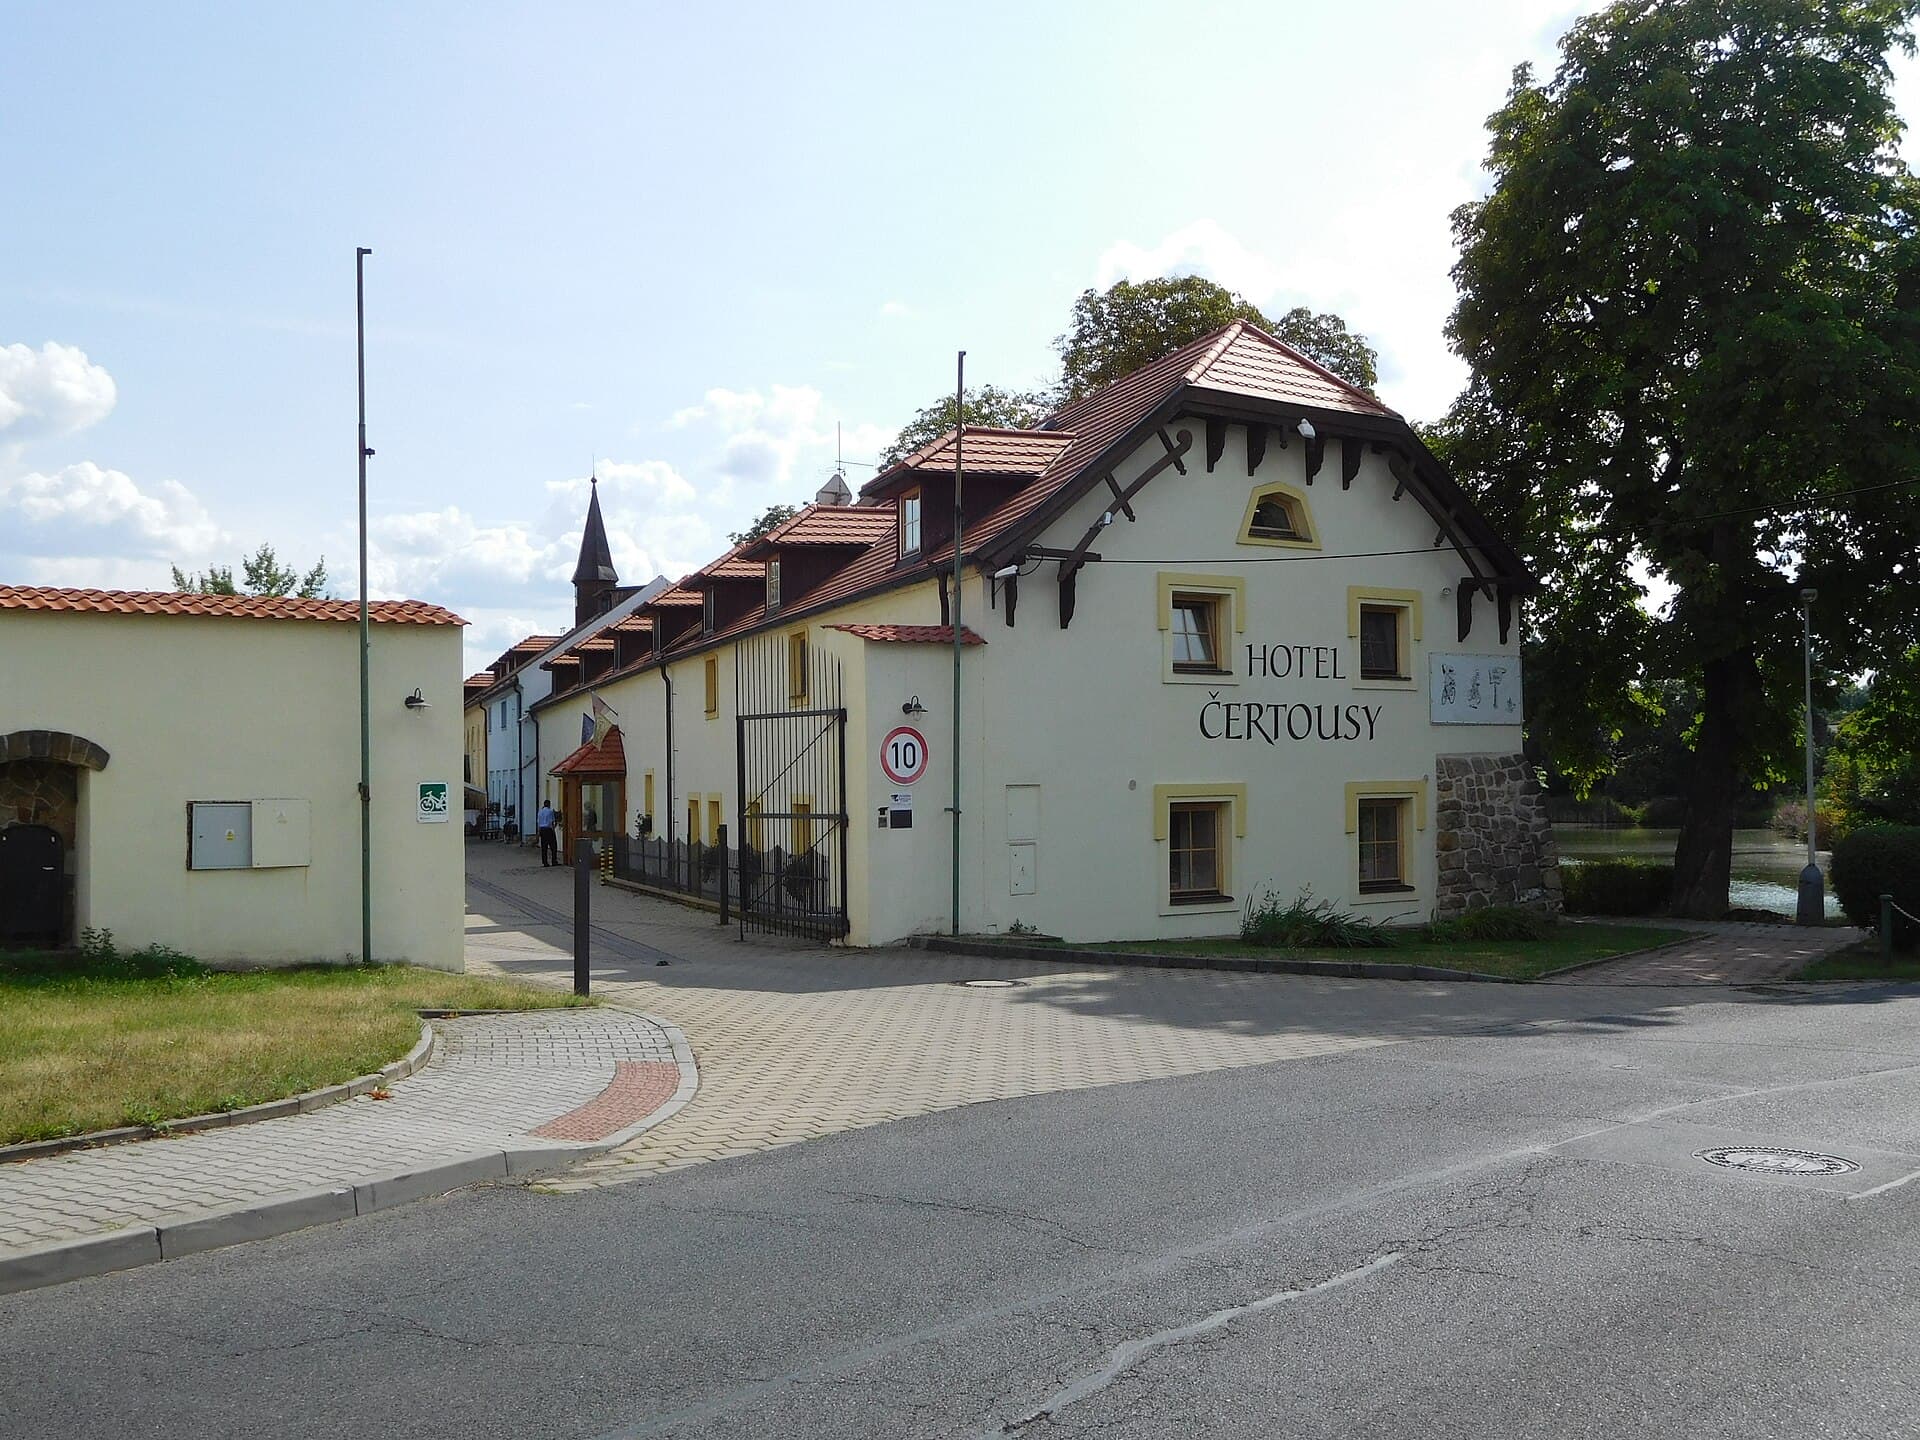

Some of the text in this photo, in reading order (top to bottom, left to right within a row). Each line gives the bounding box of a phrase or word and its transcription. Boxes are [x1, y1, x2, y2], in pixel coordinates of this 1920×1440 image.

[1245, 643, 1346, 680] HOTEL
[1199, 690, 1383, 746] ČERTOUSY
[891, 742, 916, 769] 10
